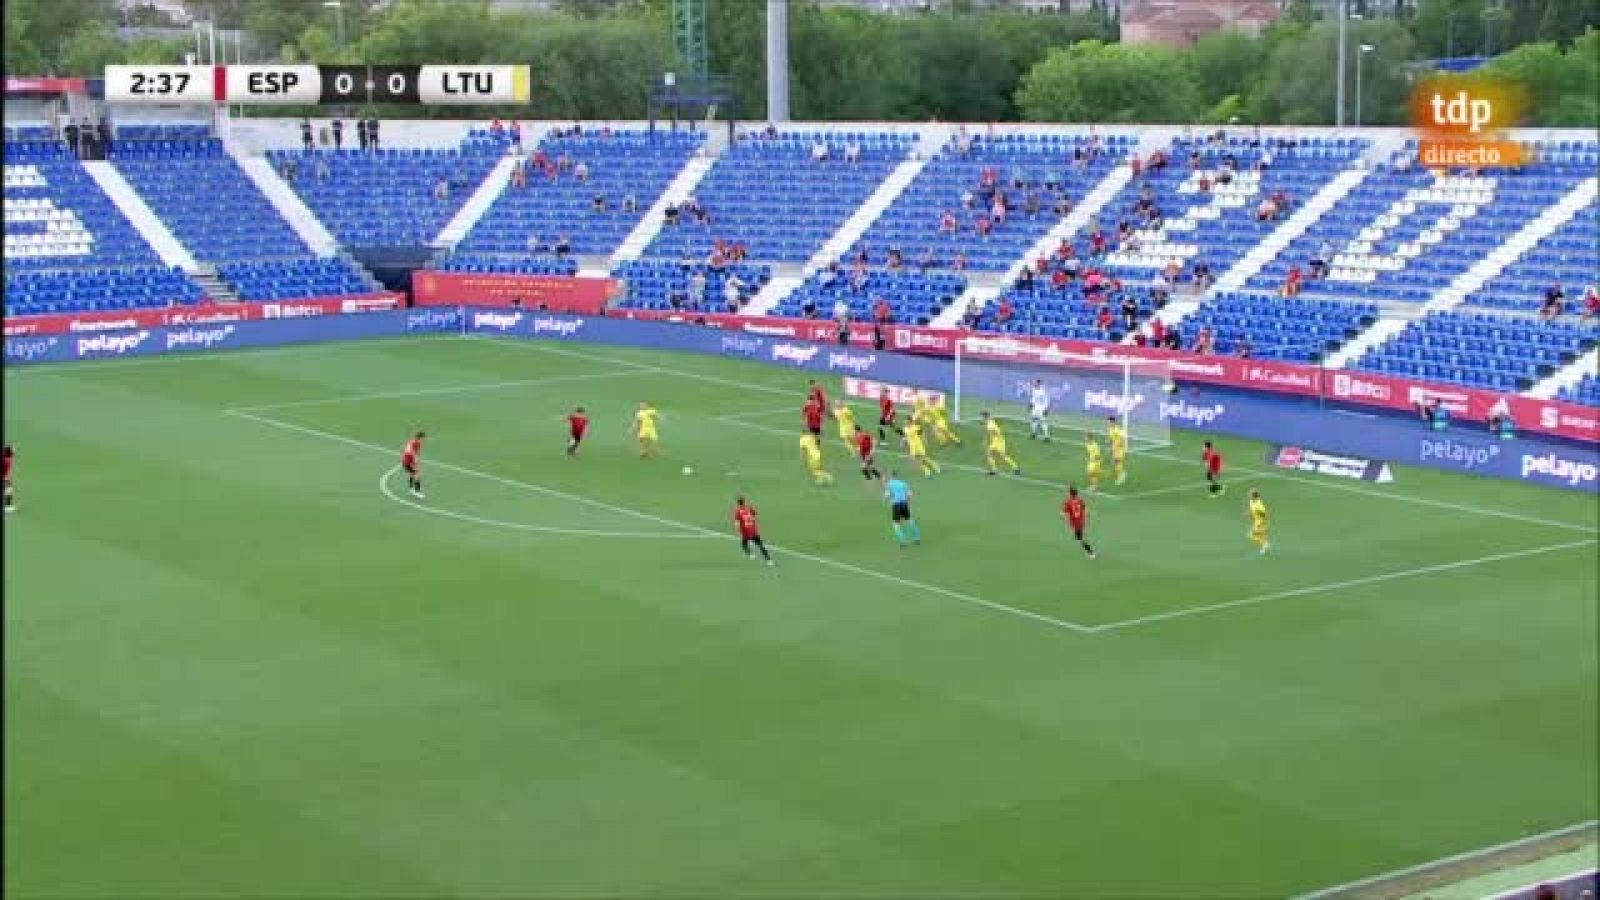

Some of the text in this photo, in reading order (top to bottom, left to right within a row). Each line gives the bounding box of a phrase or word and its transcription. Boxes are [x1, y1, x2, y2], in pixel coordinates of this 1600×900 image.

[78, 334, 139, 356] pelayo
[167, 328, 225, 349] pelayo
[1159, 400, 1215, 425] pelayo
[1420, 440, 1488, 470] pelayo
[1521, 452, 1598, 486] pelayo
